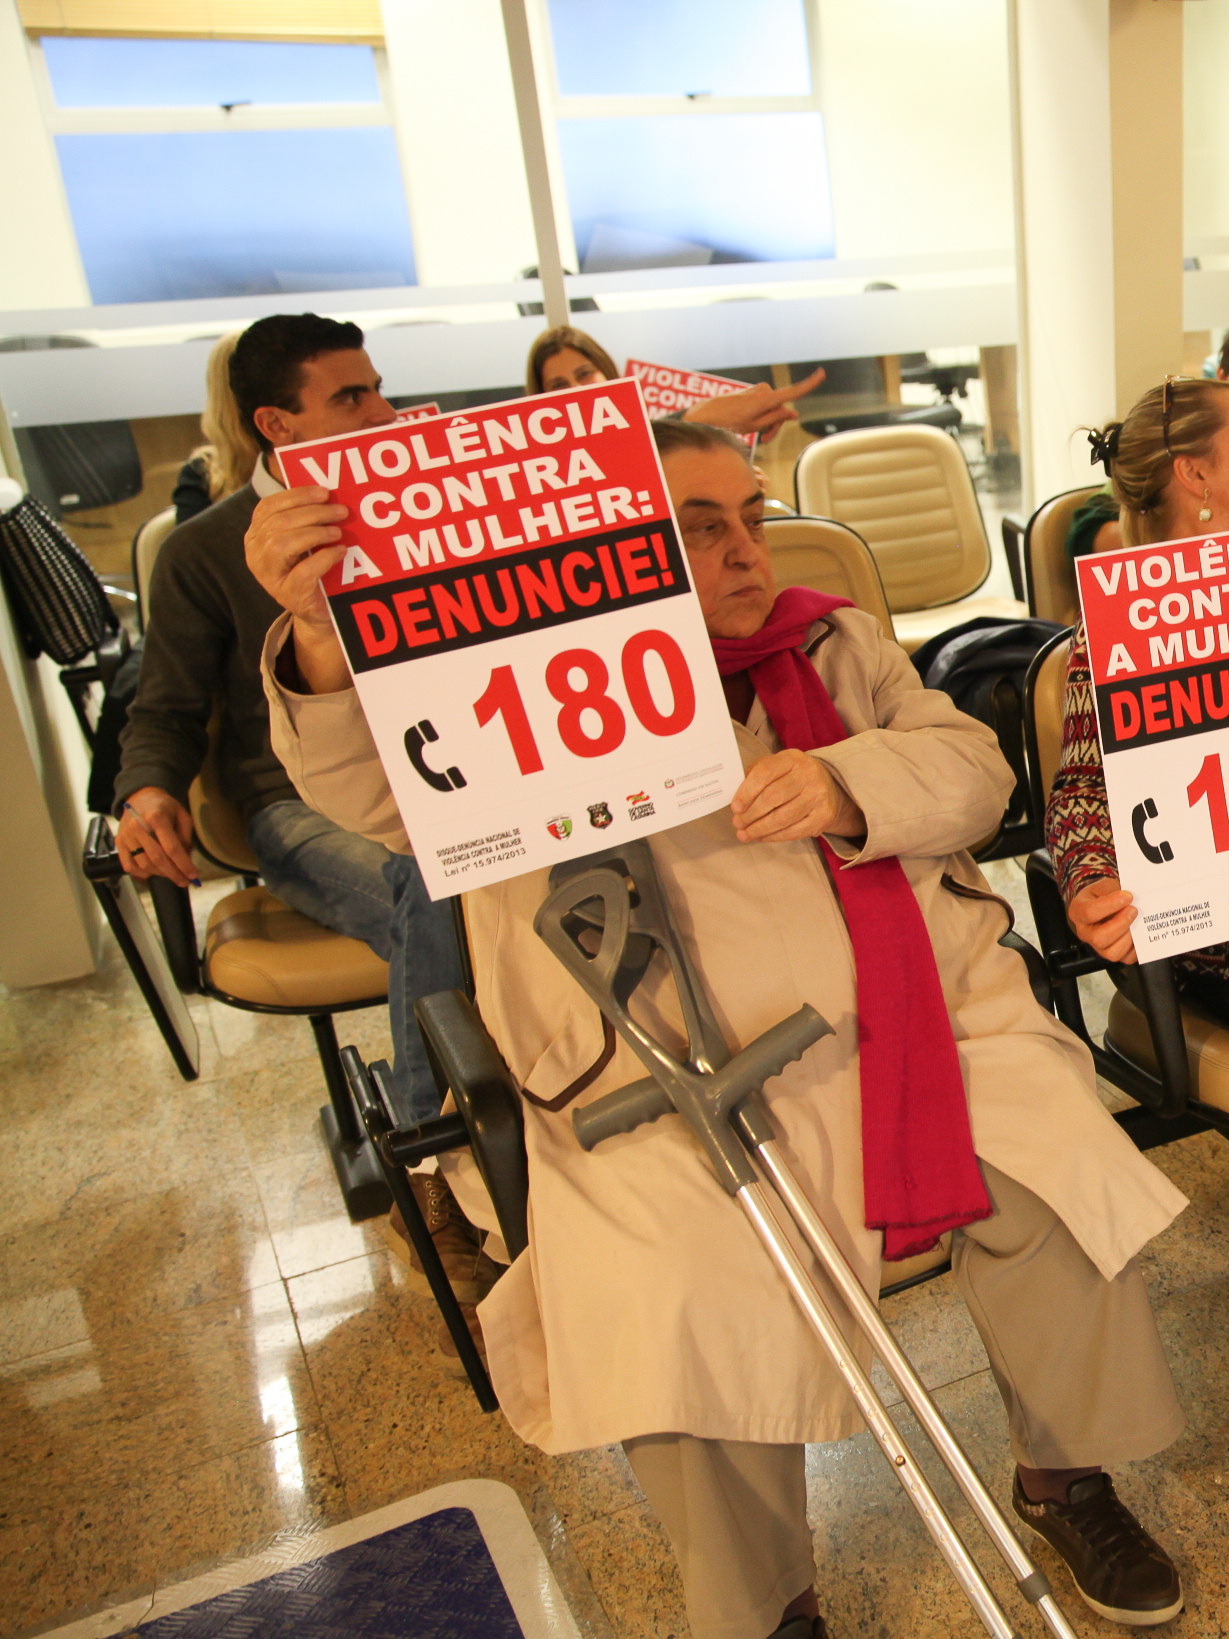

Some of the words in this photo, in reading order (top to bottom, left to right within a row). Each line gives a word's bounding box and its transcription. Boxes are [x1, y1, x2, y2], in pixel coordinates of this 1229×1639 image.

[632, 363, 747, 398] VIOLÊNC
[299, 396, 630, 490] VIOLÊNCIA
[359, 448, 607, 529] CONTRA
[341, 545, 383, 585] A
[392, 486, 655, 571] MULHER:
[350, 532, 675, 658] DENUNCIE!
[1106, 642, 1138, 677] A
[473, 629, 696, 777] 180
[441, 851, 470, 866] VIOLÊNCIA
[471, 846, 493, 858] CONTRA
[500, 837, 522, 849] MULHER
[485, 830, 512, 844] NACIONAL
[512, 827, 521, 836] DE
[444, 866, 459, 877] Lei
[473, 847, 526, 869] 15.974/2013
[1146, 920, 1169, 932] VIOLÊNCIA
[1170, 916, 1187, 926] CONTRA
[1193, 910, 1210, 920] MULHER
[1182, 903, 1203, 913] NACIONAL
[1203, 900, 1210, 909] DE
[1148, 933, 1161, 943] Lei
[1171, 919, 1213, 937] 15.974/2013
